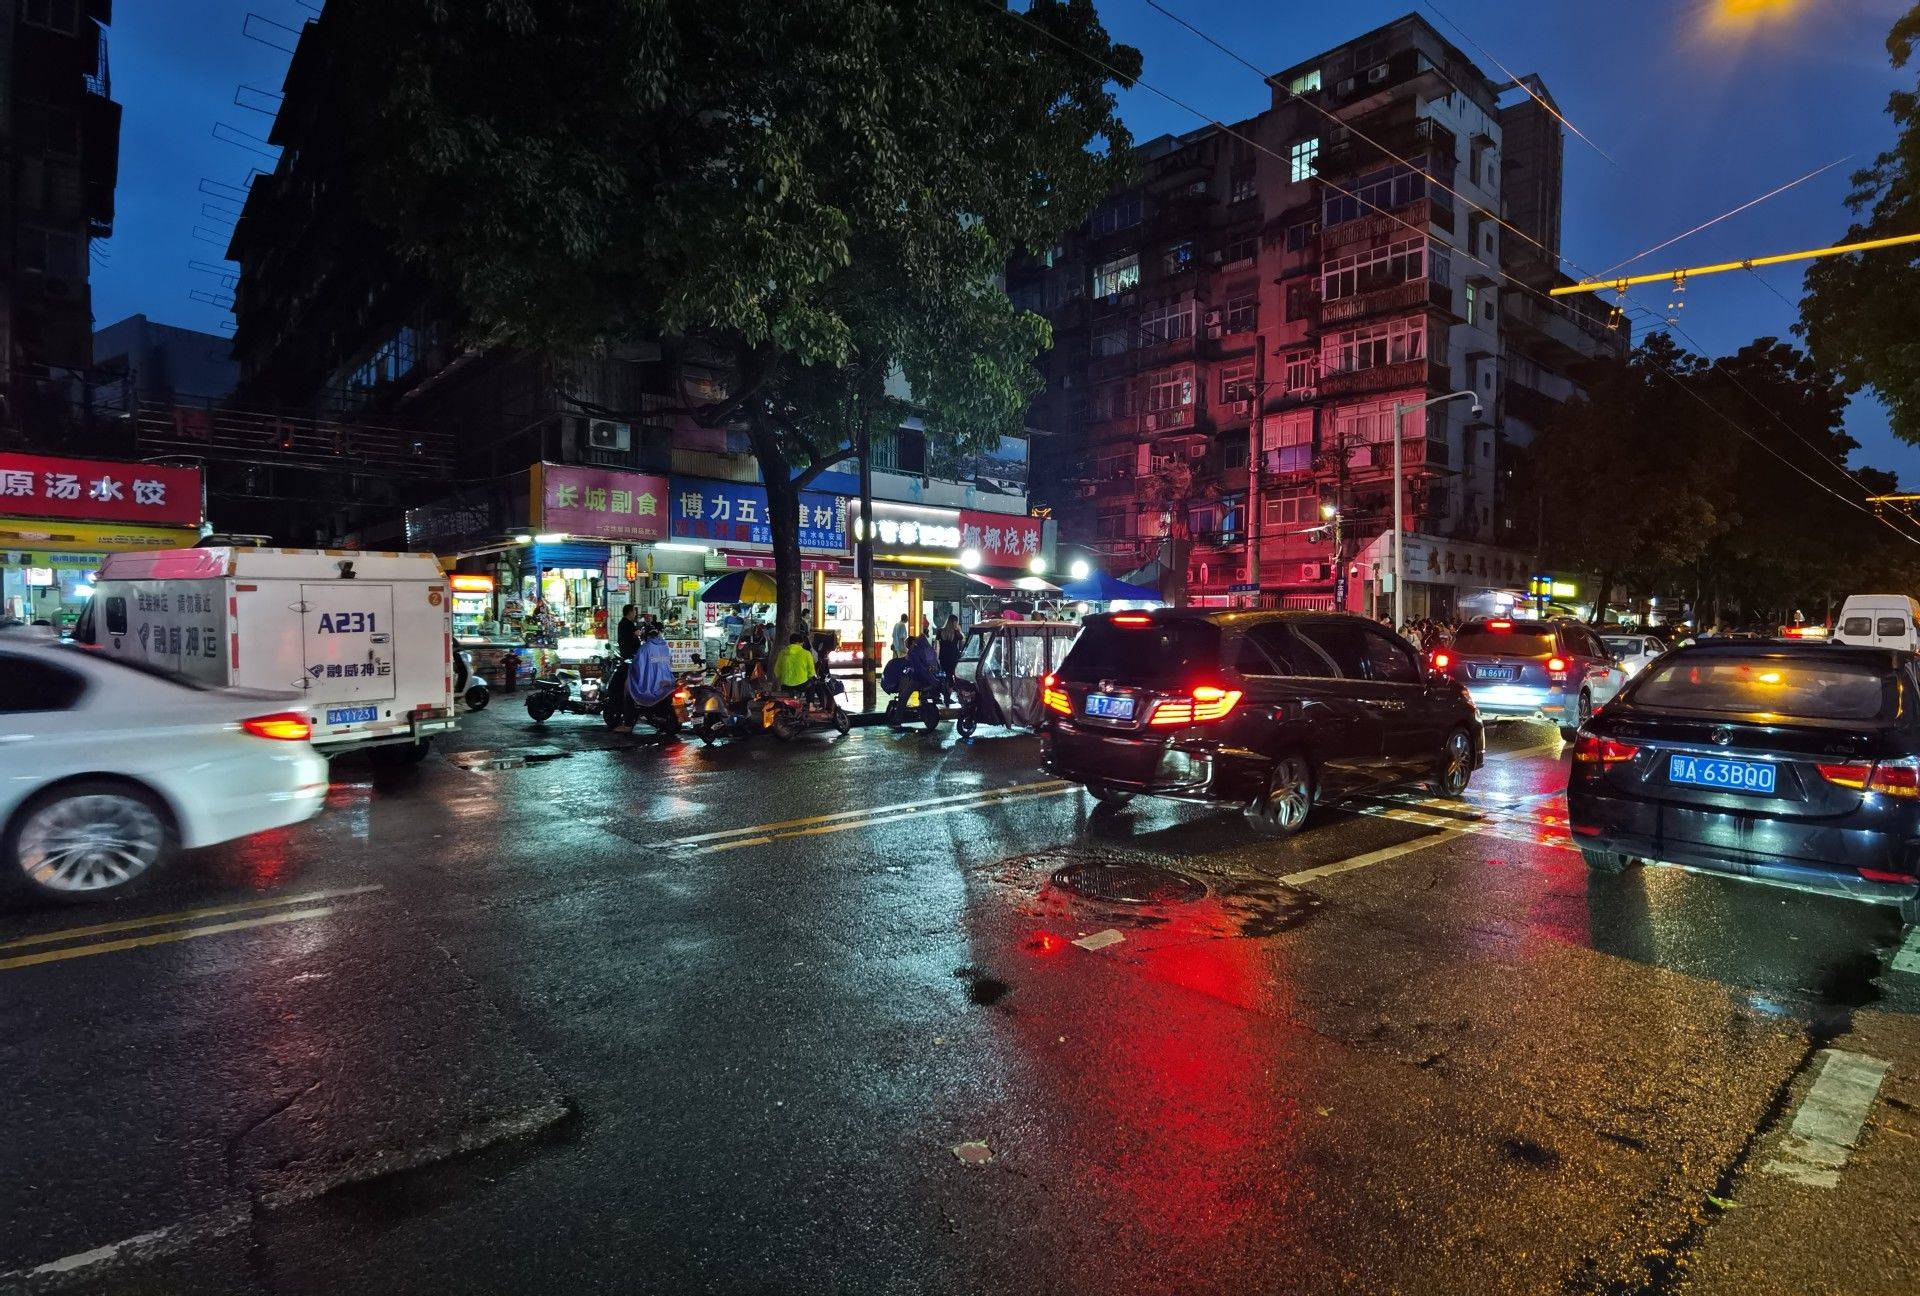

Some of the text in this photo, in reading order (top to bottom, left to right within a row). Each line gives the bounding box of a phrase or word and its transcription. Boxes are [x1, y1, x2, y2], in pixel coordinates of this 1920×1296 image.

[0, 470, 165, 505] 原汤水饺
[556, 484, 657, 516] 长城副食
[834, 495, 846, 533] 经营部
[318, 612, 376, 634] A231
[326, 662, 391, 678] 融威押运
